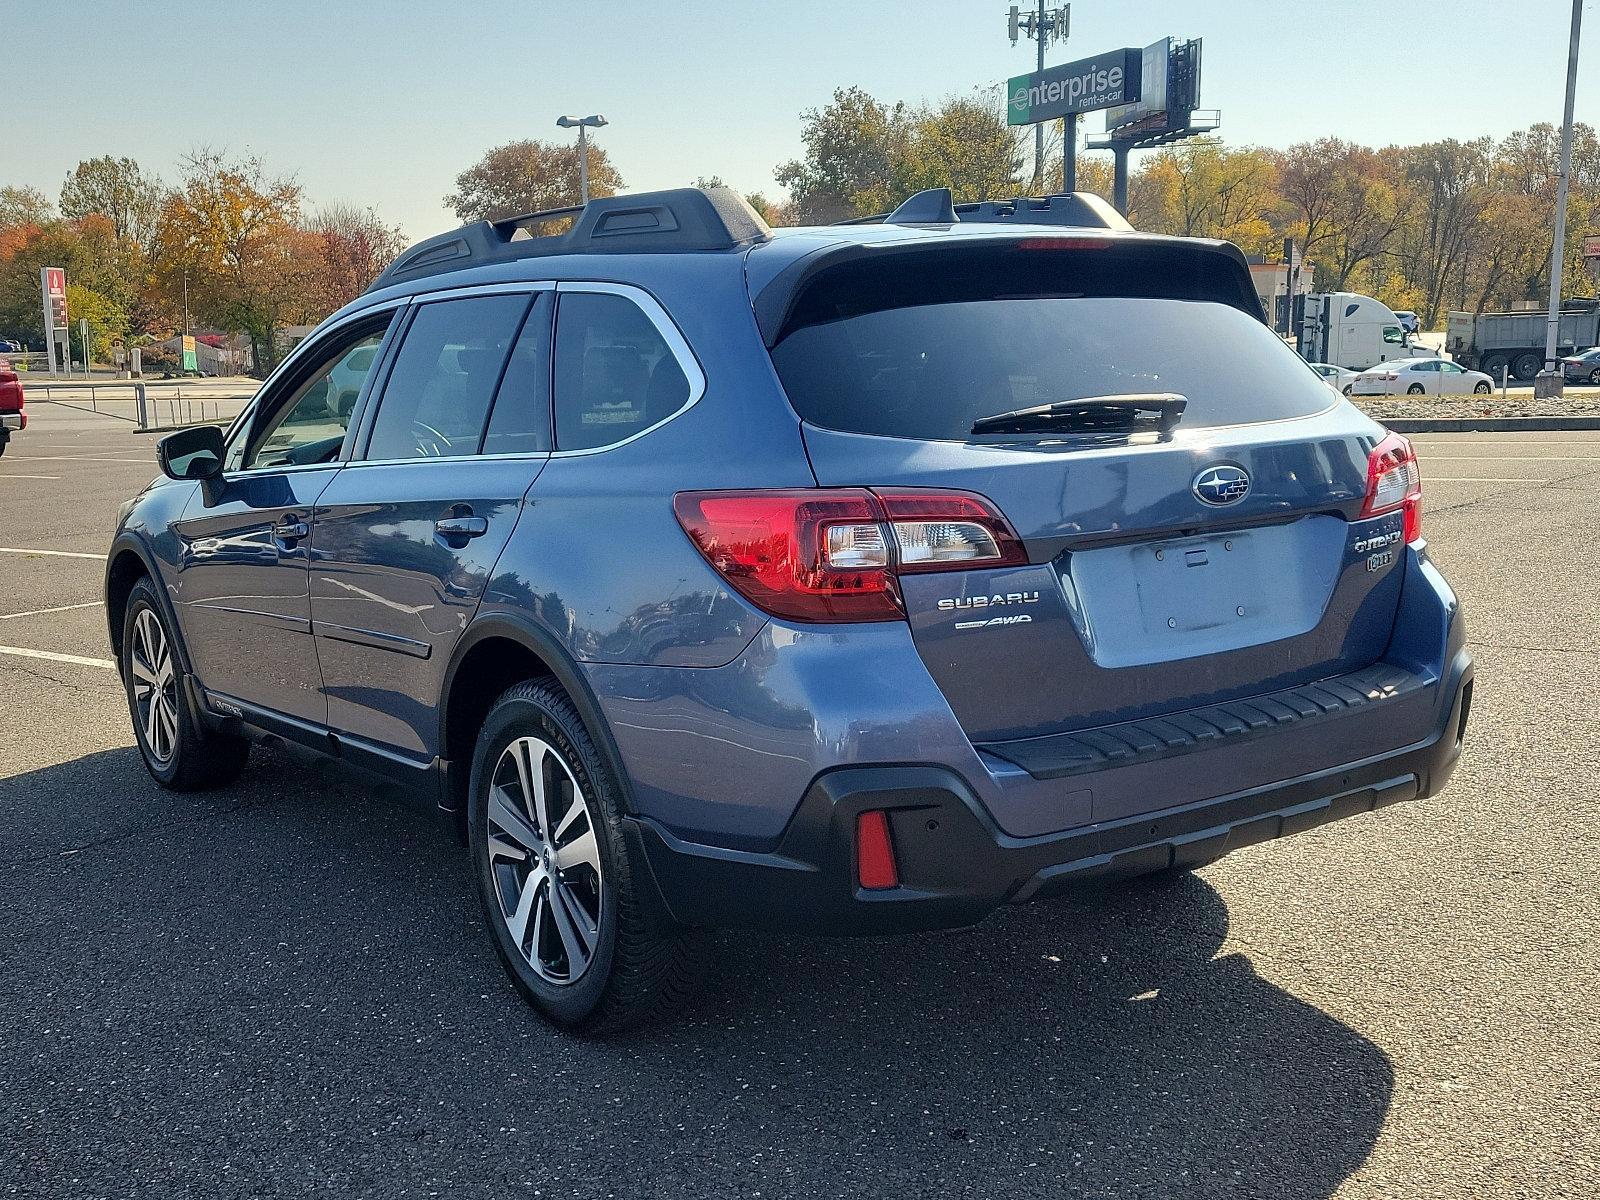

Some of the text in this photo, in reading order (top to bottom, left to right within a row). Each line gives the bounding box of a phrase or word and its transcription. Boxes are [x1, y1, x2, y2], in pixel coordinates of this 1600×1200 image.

[1009, 65, 1123, 110] enterprise
[1079, 90, 1122, 108] rent-a-car
[937, 591, 1039, 611] SUBARU
[984, 614, 1033, 626] AWD
